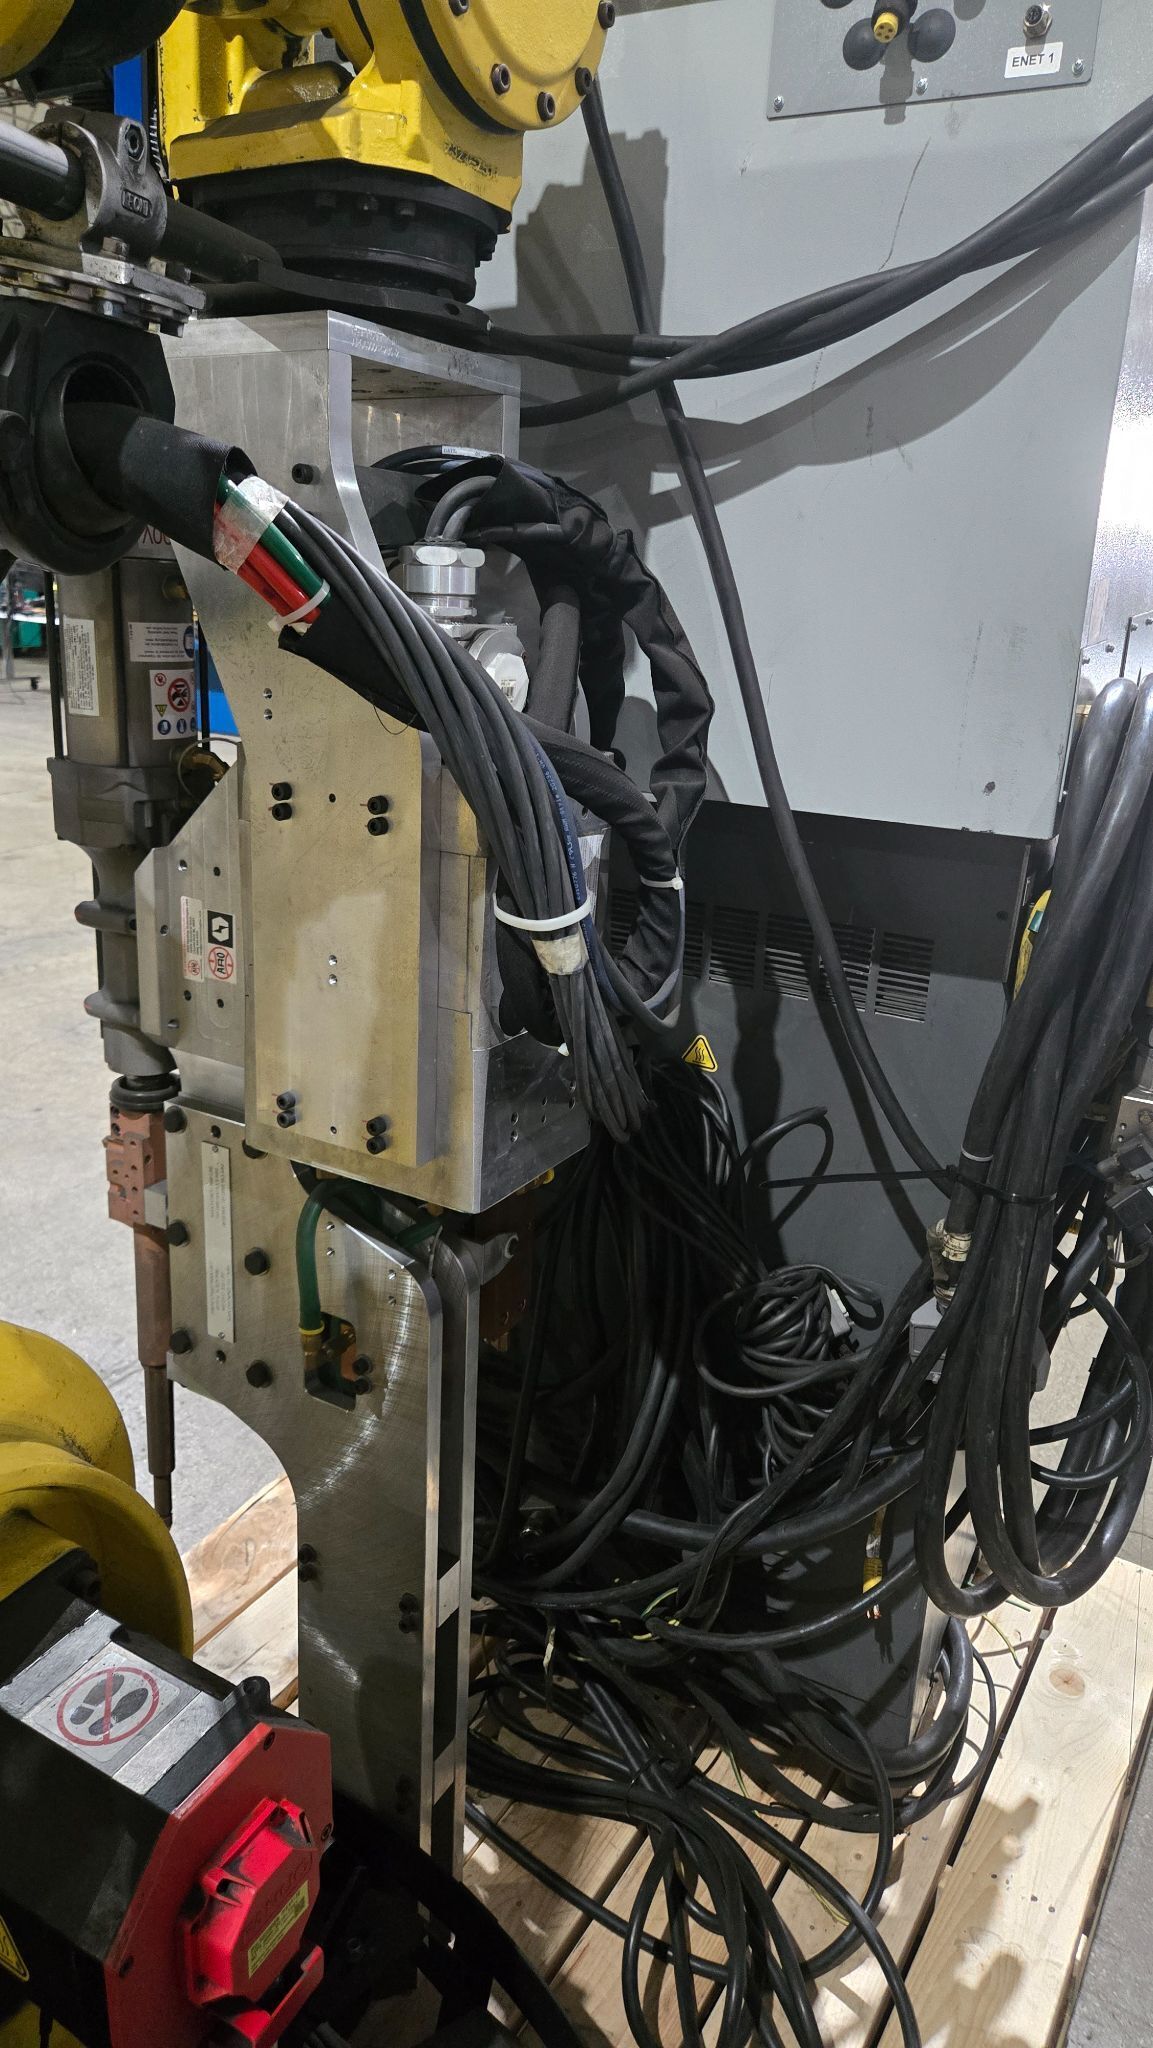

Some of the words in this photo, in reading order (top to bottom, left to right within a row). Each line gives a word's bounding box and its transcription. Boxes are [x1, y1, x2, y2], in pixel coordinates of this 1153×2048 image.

[1012, 53, 1045, 67] ENET
[1048, 53, 1054, 63] 1
[217, 952, 226, 974] ARO
